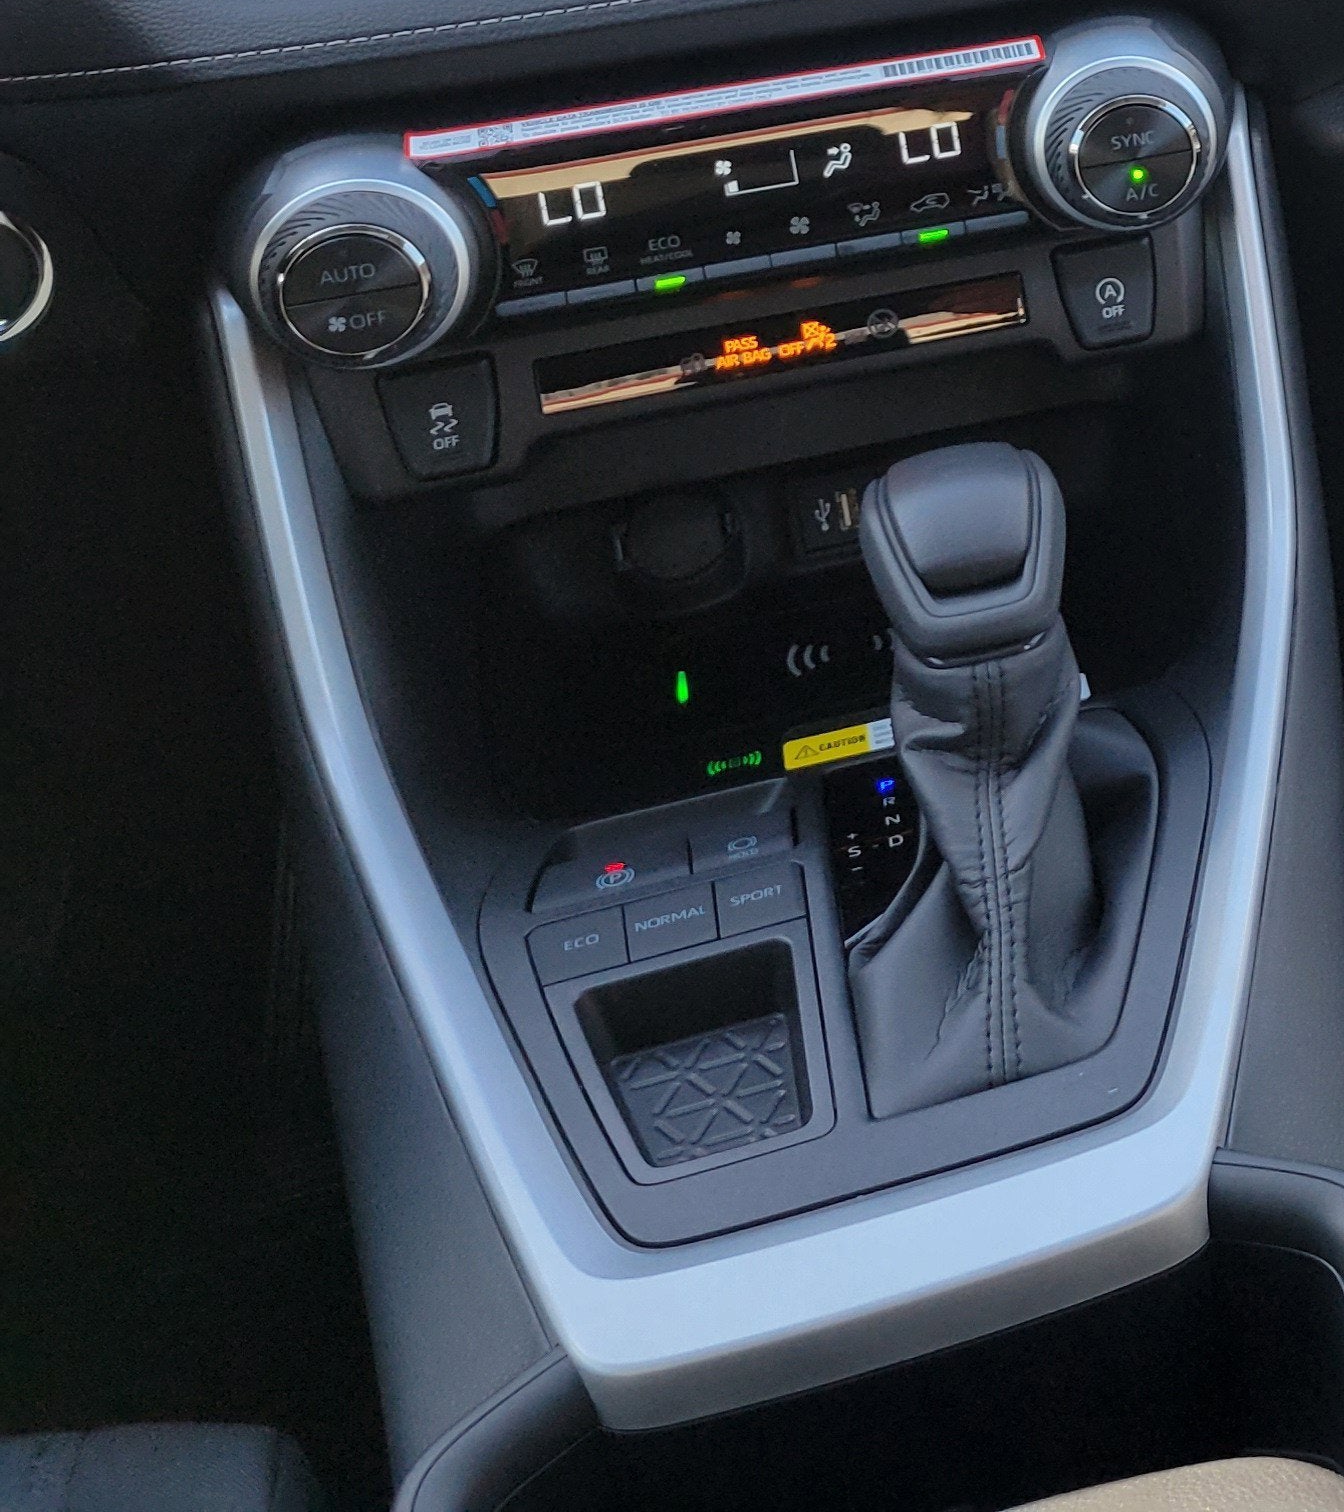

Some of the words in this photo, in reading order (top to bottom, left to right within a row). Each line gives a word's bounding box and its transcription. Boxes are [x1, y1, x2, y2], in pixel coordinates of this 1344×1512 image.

[1110, 129, 1155, 151] SYNC
[1125, 183, 1160, 202] A/C
[648, 235, 681, 251] ECO
[320, 263, 376, 285] AUTO
[349, 310, 385, 330] OFF
[1102, 304, 1126, 319] OFF
[724, 336, 759, 354] PASS
[716, 354, 741, 370] AIR
[741, 347, 772, 364] BAG
[778, 341, 804, 358] OFF
[432, 434, 460, 450] OFF
[818, 733, 867, 752] CAUTION
[883, 796, 896, 807] R
[885, 814, 901, 826] N
[847, 845, 862, 858] S
[888, 834, 904, 848] D
[730, 884, 783, 906] SPORT
[634, 905, 706, 932] NORMAL
[563, 933, 600, 951] ECO
